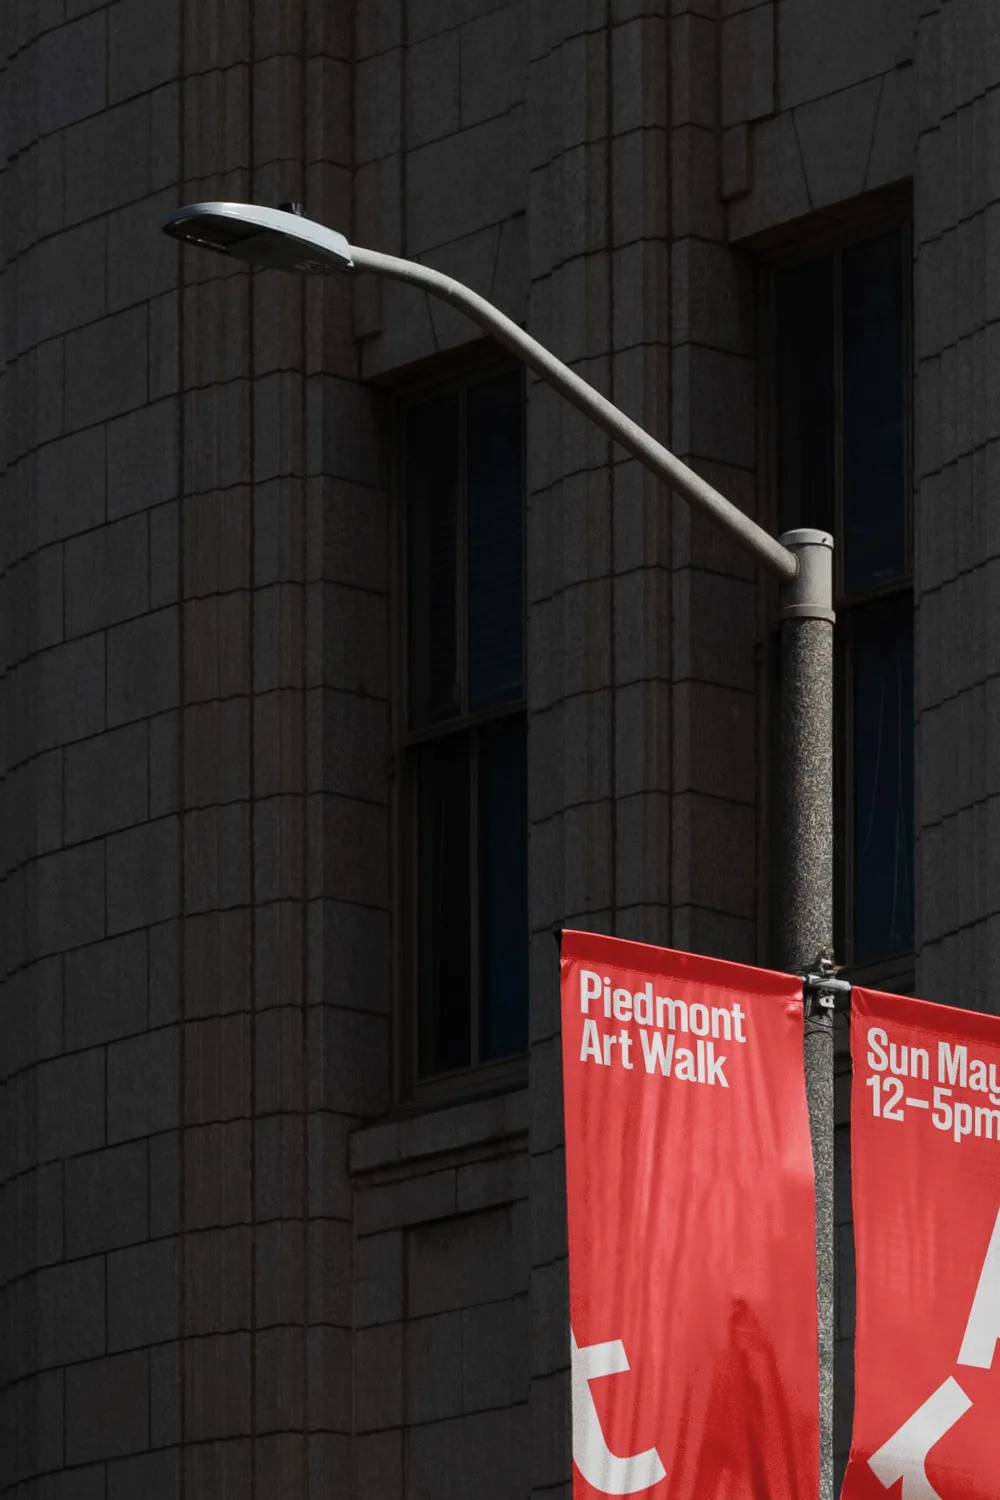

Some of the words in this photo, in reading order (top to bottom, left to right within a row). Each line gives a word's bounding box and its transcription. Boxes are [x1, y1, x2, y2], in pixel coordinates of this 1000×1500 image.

[580, 969, 746, 1043] Piedmont
[579, 1018, 633, 1070] Art
[639, 1028, 729, 1088] Walk
[867, 1027, 930, 1080] Sun
